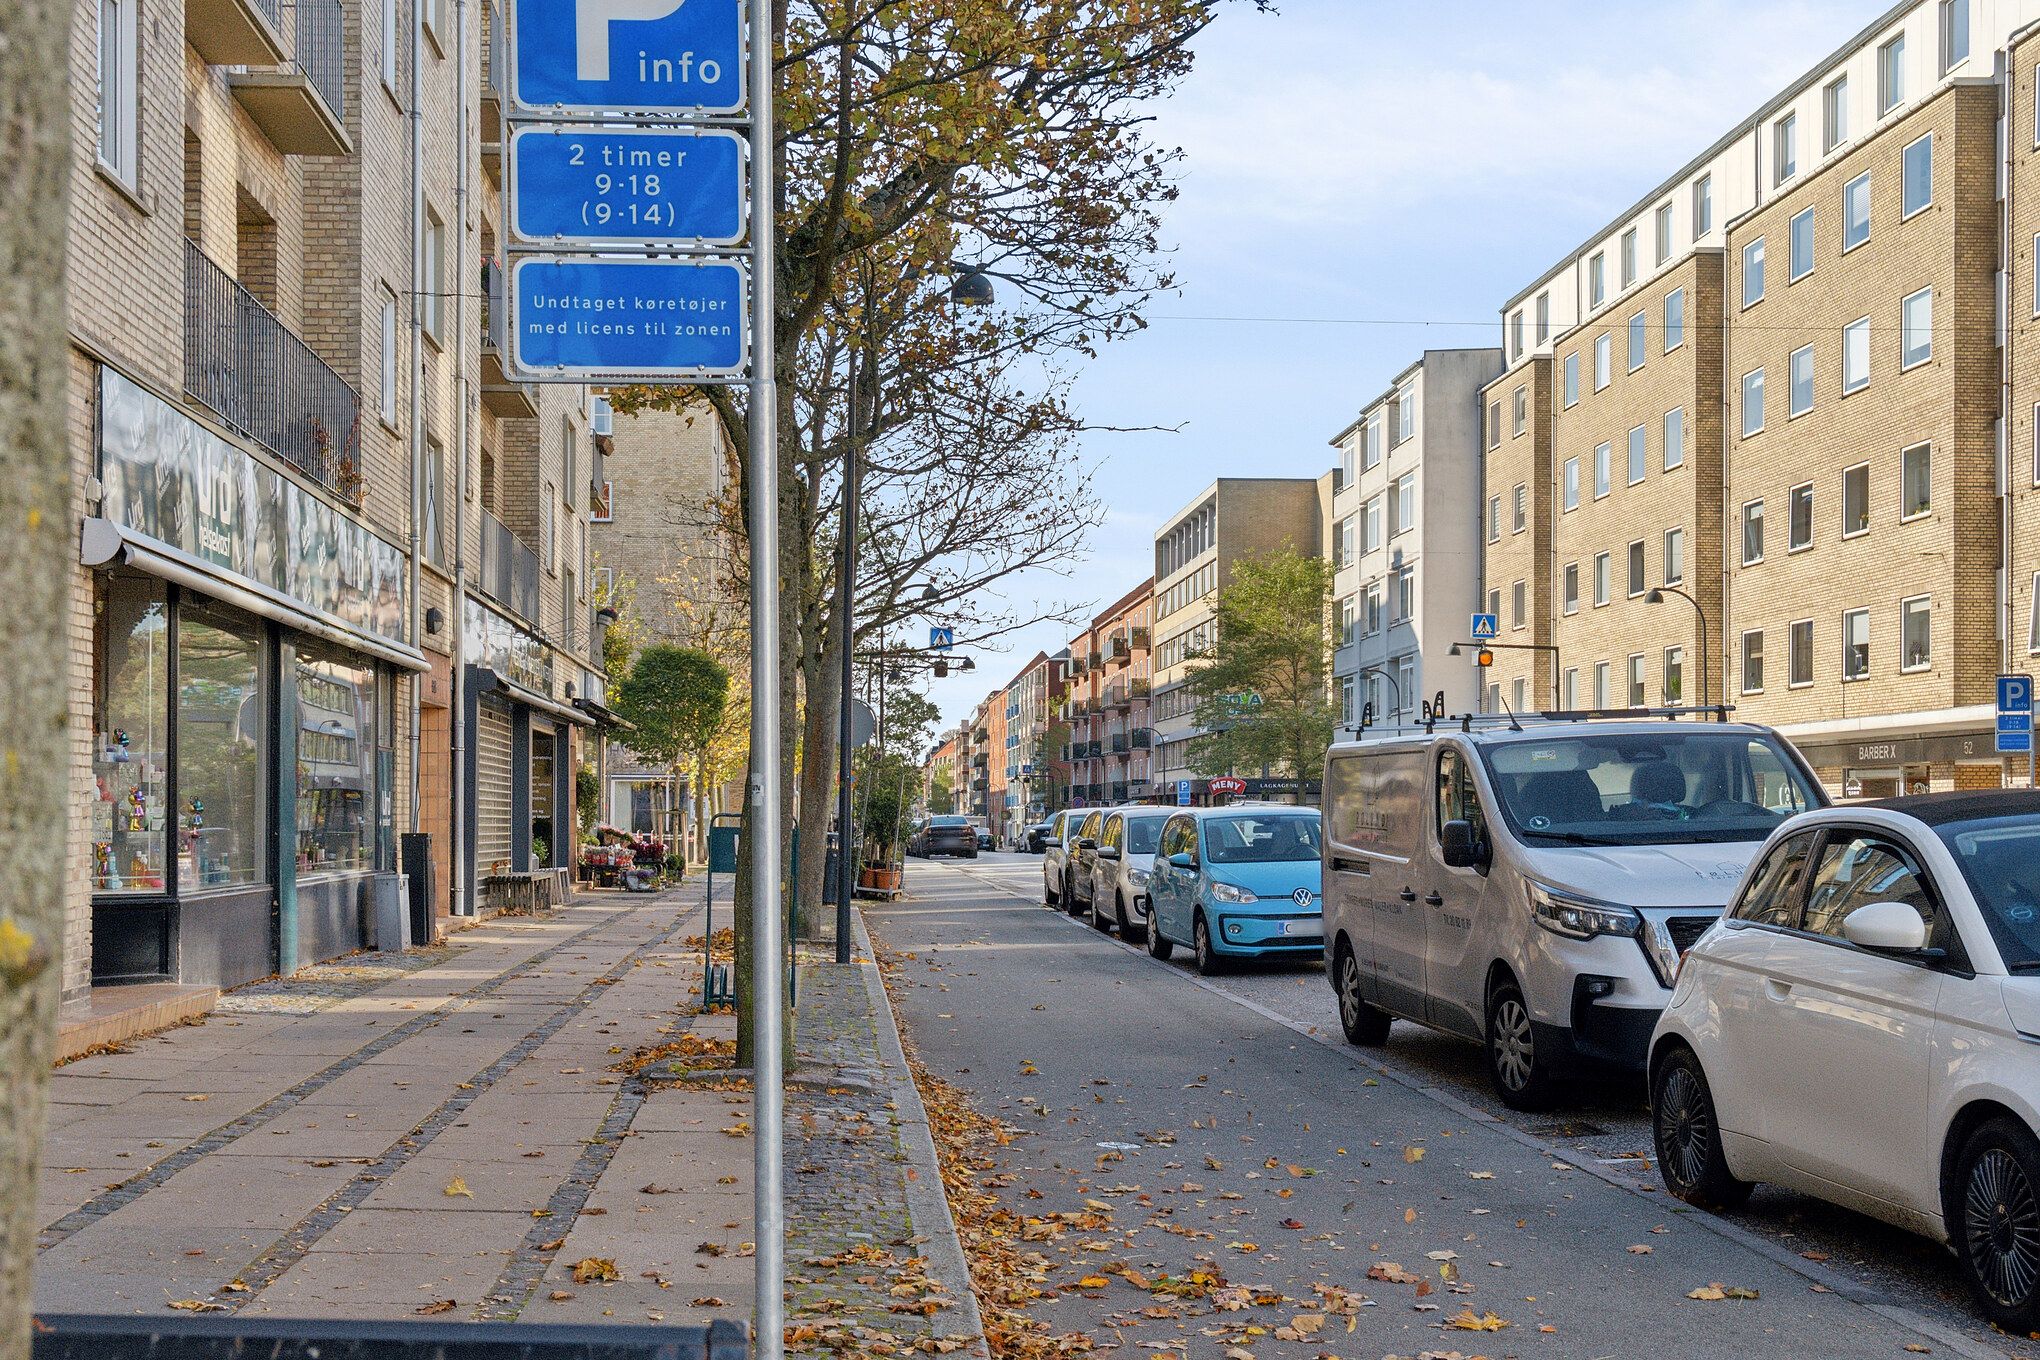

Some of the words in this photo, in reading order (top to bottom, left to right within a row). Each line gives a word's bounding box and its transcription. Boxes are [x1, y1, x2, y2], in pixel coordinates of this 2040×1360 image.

[638, 51, 722, 84] info
[569, 144, 585, 166] 2
[602, 145, 688, 167] timer
[595, 174, 661, 197] 9-18
[581, 201, 676, 227] (9-14)
[533, 295, 626, 313] Undtaget
[635, 296, 727, 313] køretøjer
[530, 321, 568, 335] med
[576, 322, 635, 336] licens
[644, 322, 667, 336] til
[675, 324, 731, 337] zonen
[2006, 682, 2024, 708] P
[1858, 746, 1889, 760] BARBER
[1890, 744, 1896, 758] X
[1963, 741, 1973, 755] 52
[1211, 780, 1242, 790] MENY
